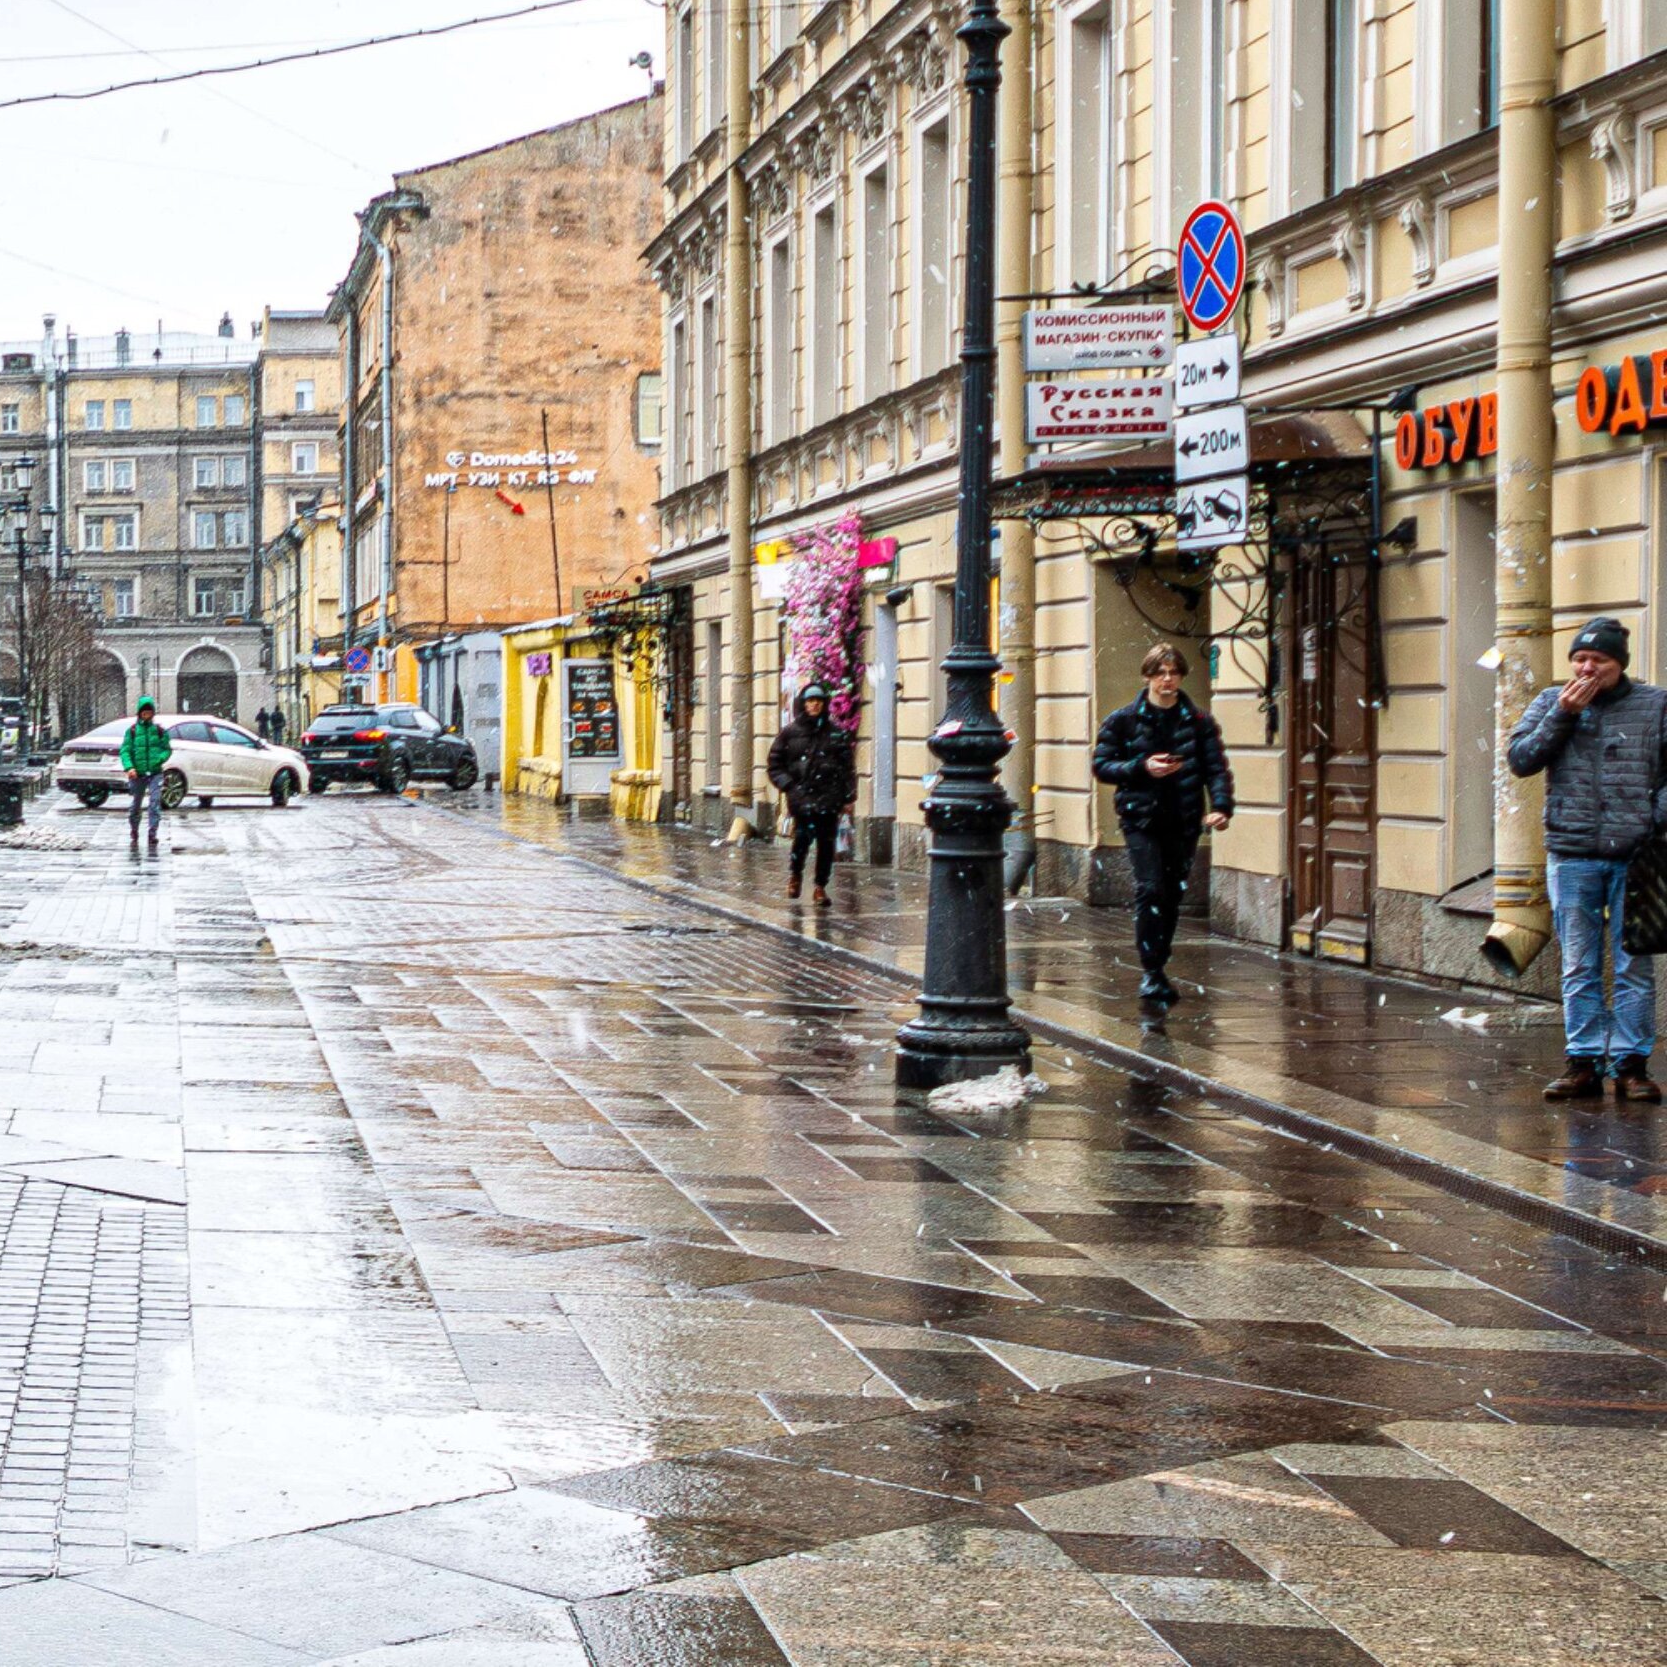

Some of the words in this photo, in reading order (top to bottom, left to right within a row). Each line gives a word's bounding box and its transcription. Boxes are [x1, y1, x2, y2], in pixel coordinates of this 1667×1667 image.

[1034, 309, 1166, 327] КОМИССИОННЫЙ
[1039, 384, 1163, 403] Русская
[1050, 405, 1155, 422] Сказка
[1395, 391, 1498, 471] ОБУВ
[468, 472, 500, 487] УЗИ
